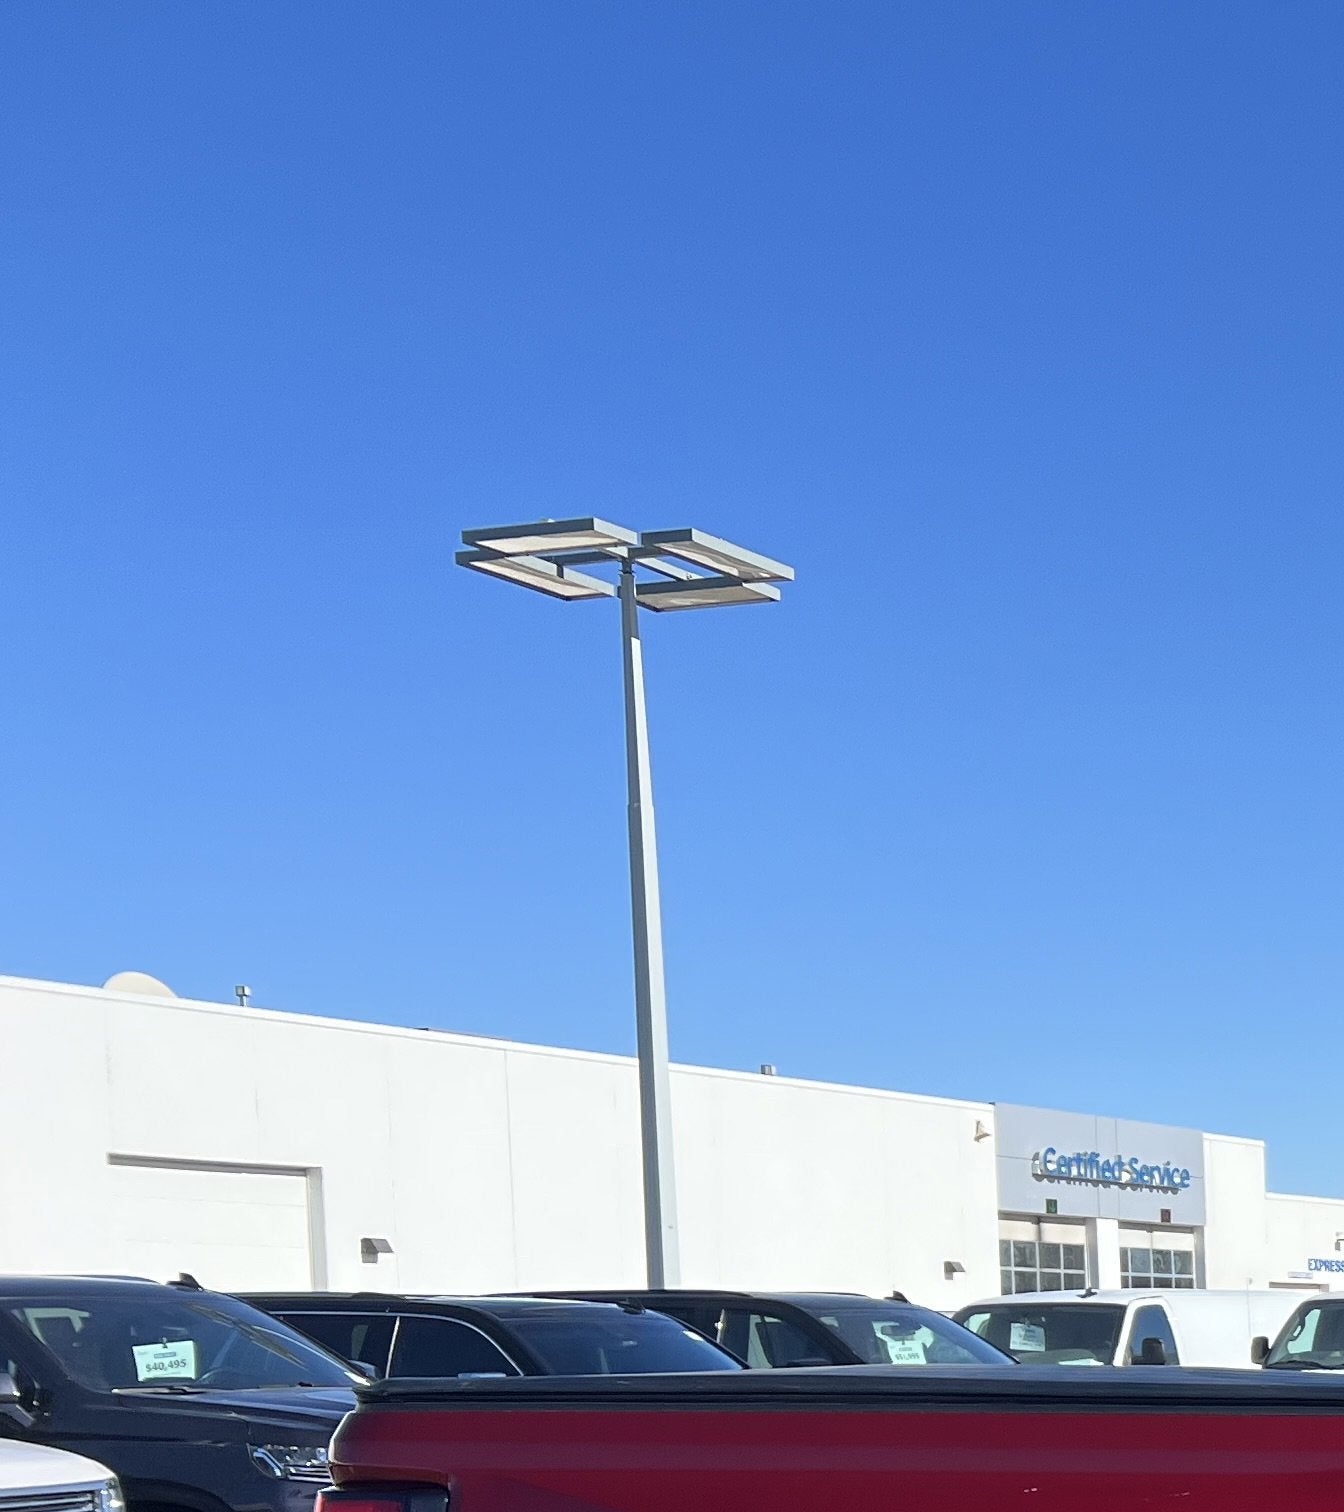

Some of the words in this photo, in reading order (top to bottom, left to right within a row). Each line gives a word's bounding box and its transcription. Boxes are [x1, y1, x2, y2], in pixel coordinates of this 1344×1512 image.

[1043, 1147, 1125, 1182] Certified
[1127, 1157, 1191, 1188] Service
[145, 1359, 187, 1372] $40,495
